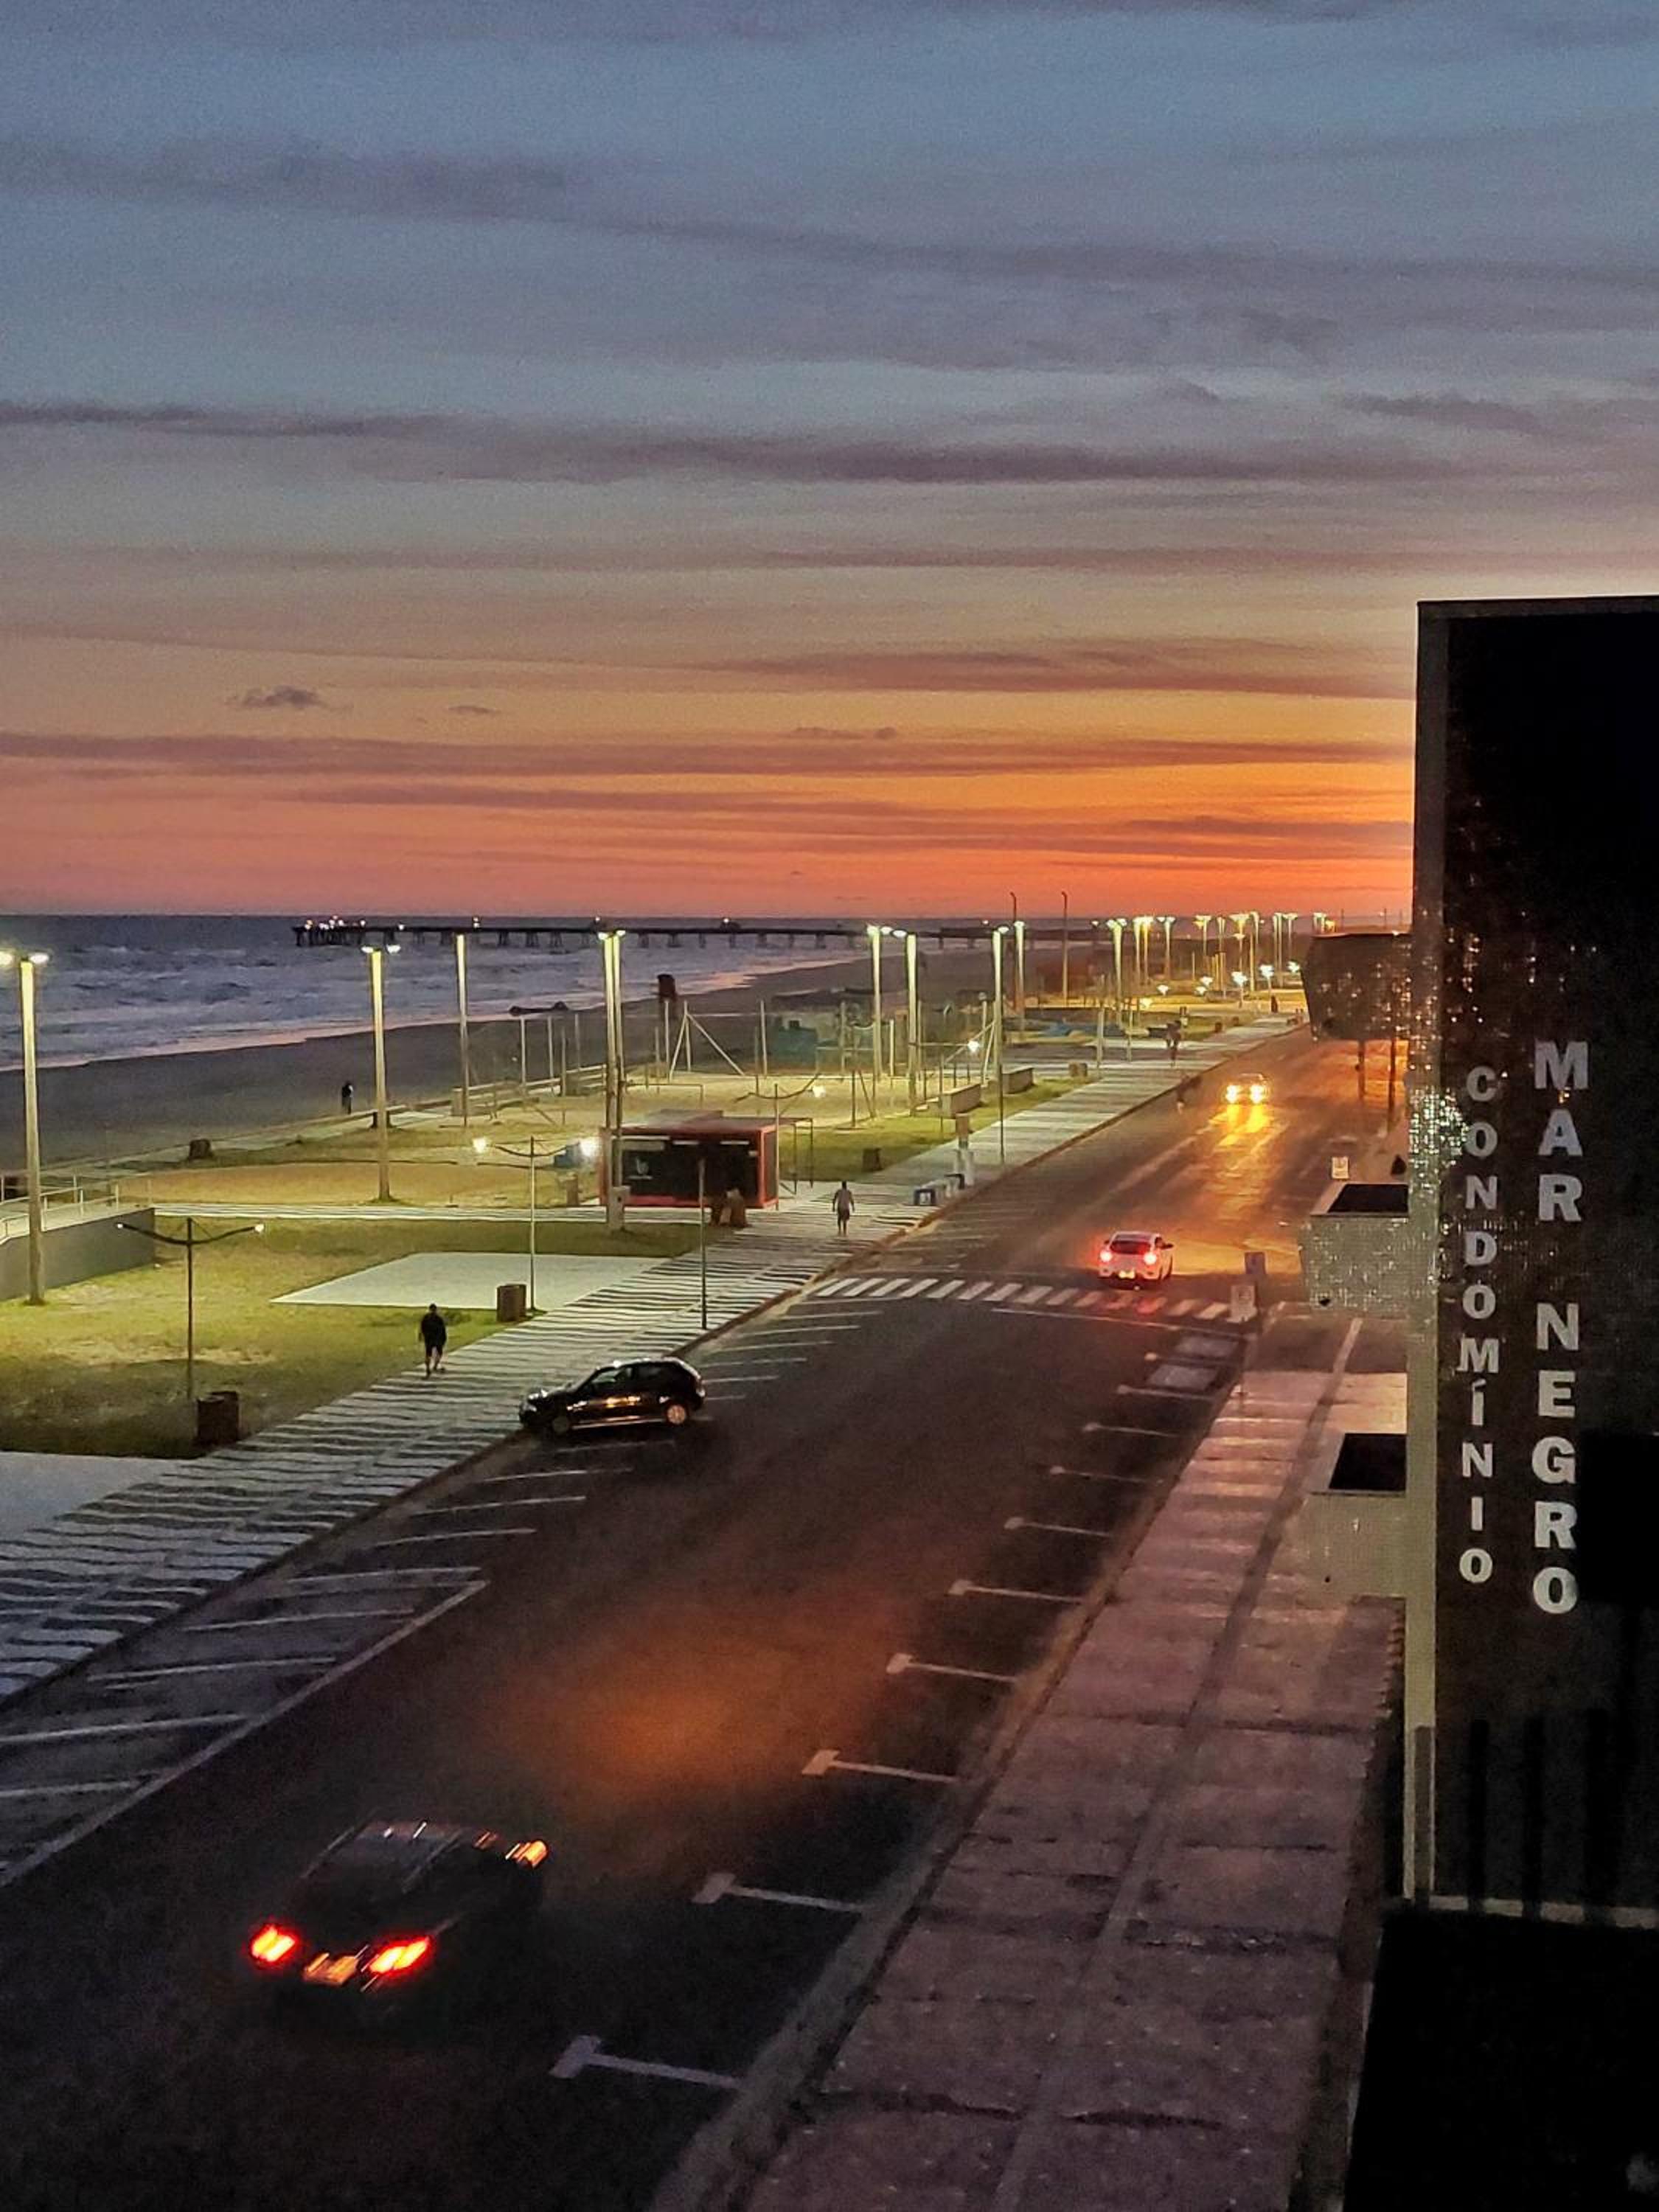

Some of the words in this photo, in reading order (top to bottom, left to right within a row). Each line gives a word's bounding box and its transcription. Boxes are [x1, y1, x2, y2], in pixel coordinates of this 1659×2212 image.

[1534, 1039, 1590, 1222] MAR
[1457, 1065, 1500, 1584] CONDOMÍNIO
[1531, 1302, 1579, 1615] NEGRO
